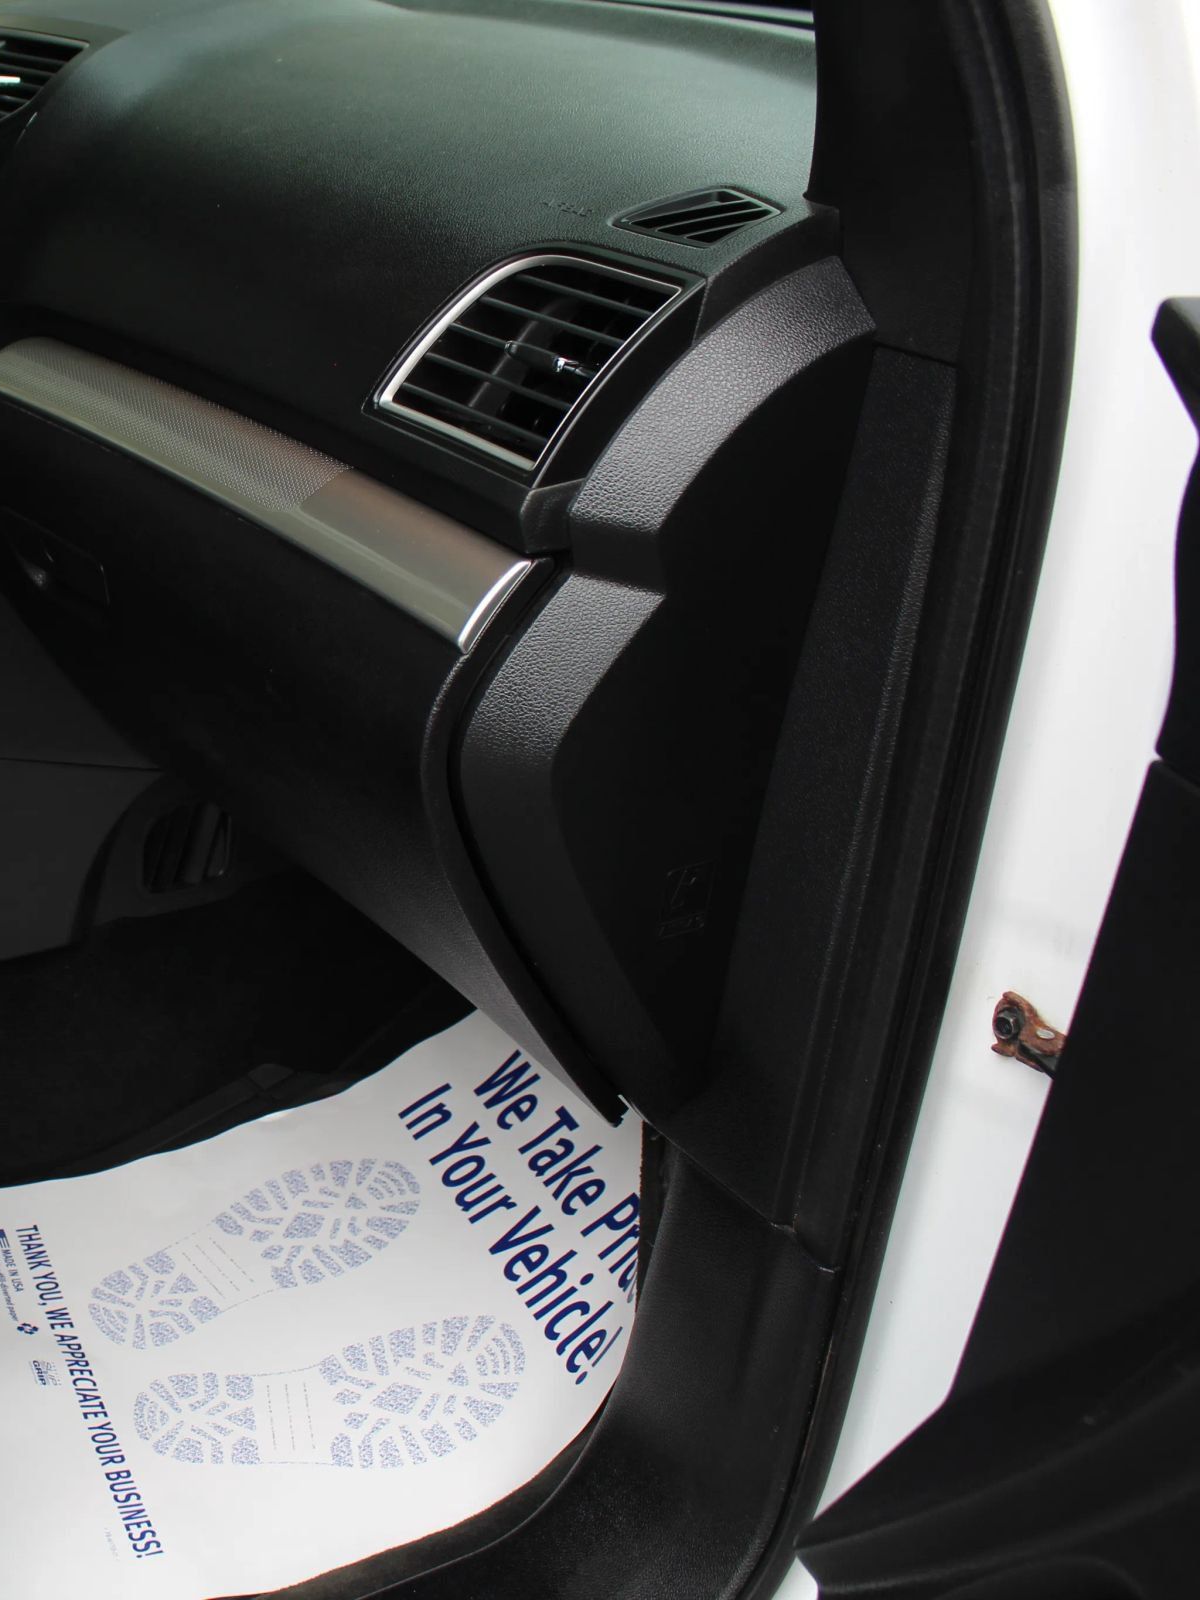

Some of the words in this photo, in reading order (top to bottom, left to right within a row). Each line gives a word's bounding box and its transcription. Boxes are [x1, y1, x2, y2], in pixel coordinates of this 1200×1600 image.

[473, 1049, 541, 1130] We
[518, 1105, 606, 1216] Take
[580, 1192, 641, 1303] Pri
[15, 1224, 53, 1270] THANK
[398, 1083, 452, 1141] In
[429, 1121, 518, 1224] Your
[488, 1205, 623, 1385] Vehicle!
[1, 1249, 16, 1267] MADE
[8, 1269, 19, 1277] IN
[11, 1278, 24, 1292] USA
[32, 1271, 64, 1306] YOU,
[45, 1307, 75, 1330] WE
[33, 1360, 47, 1386] GRIP
[54, 1334, 109, 1420] APPRECIATE
[87, 1421, 126, 1467] YOUR
[104, 1469, 164, 1559] BUSINESS!
